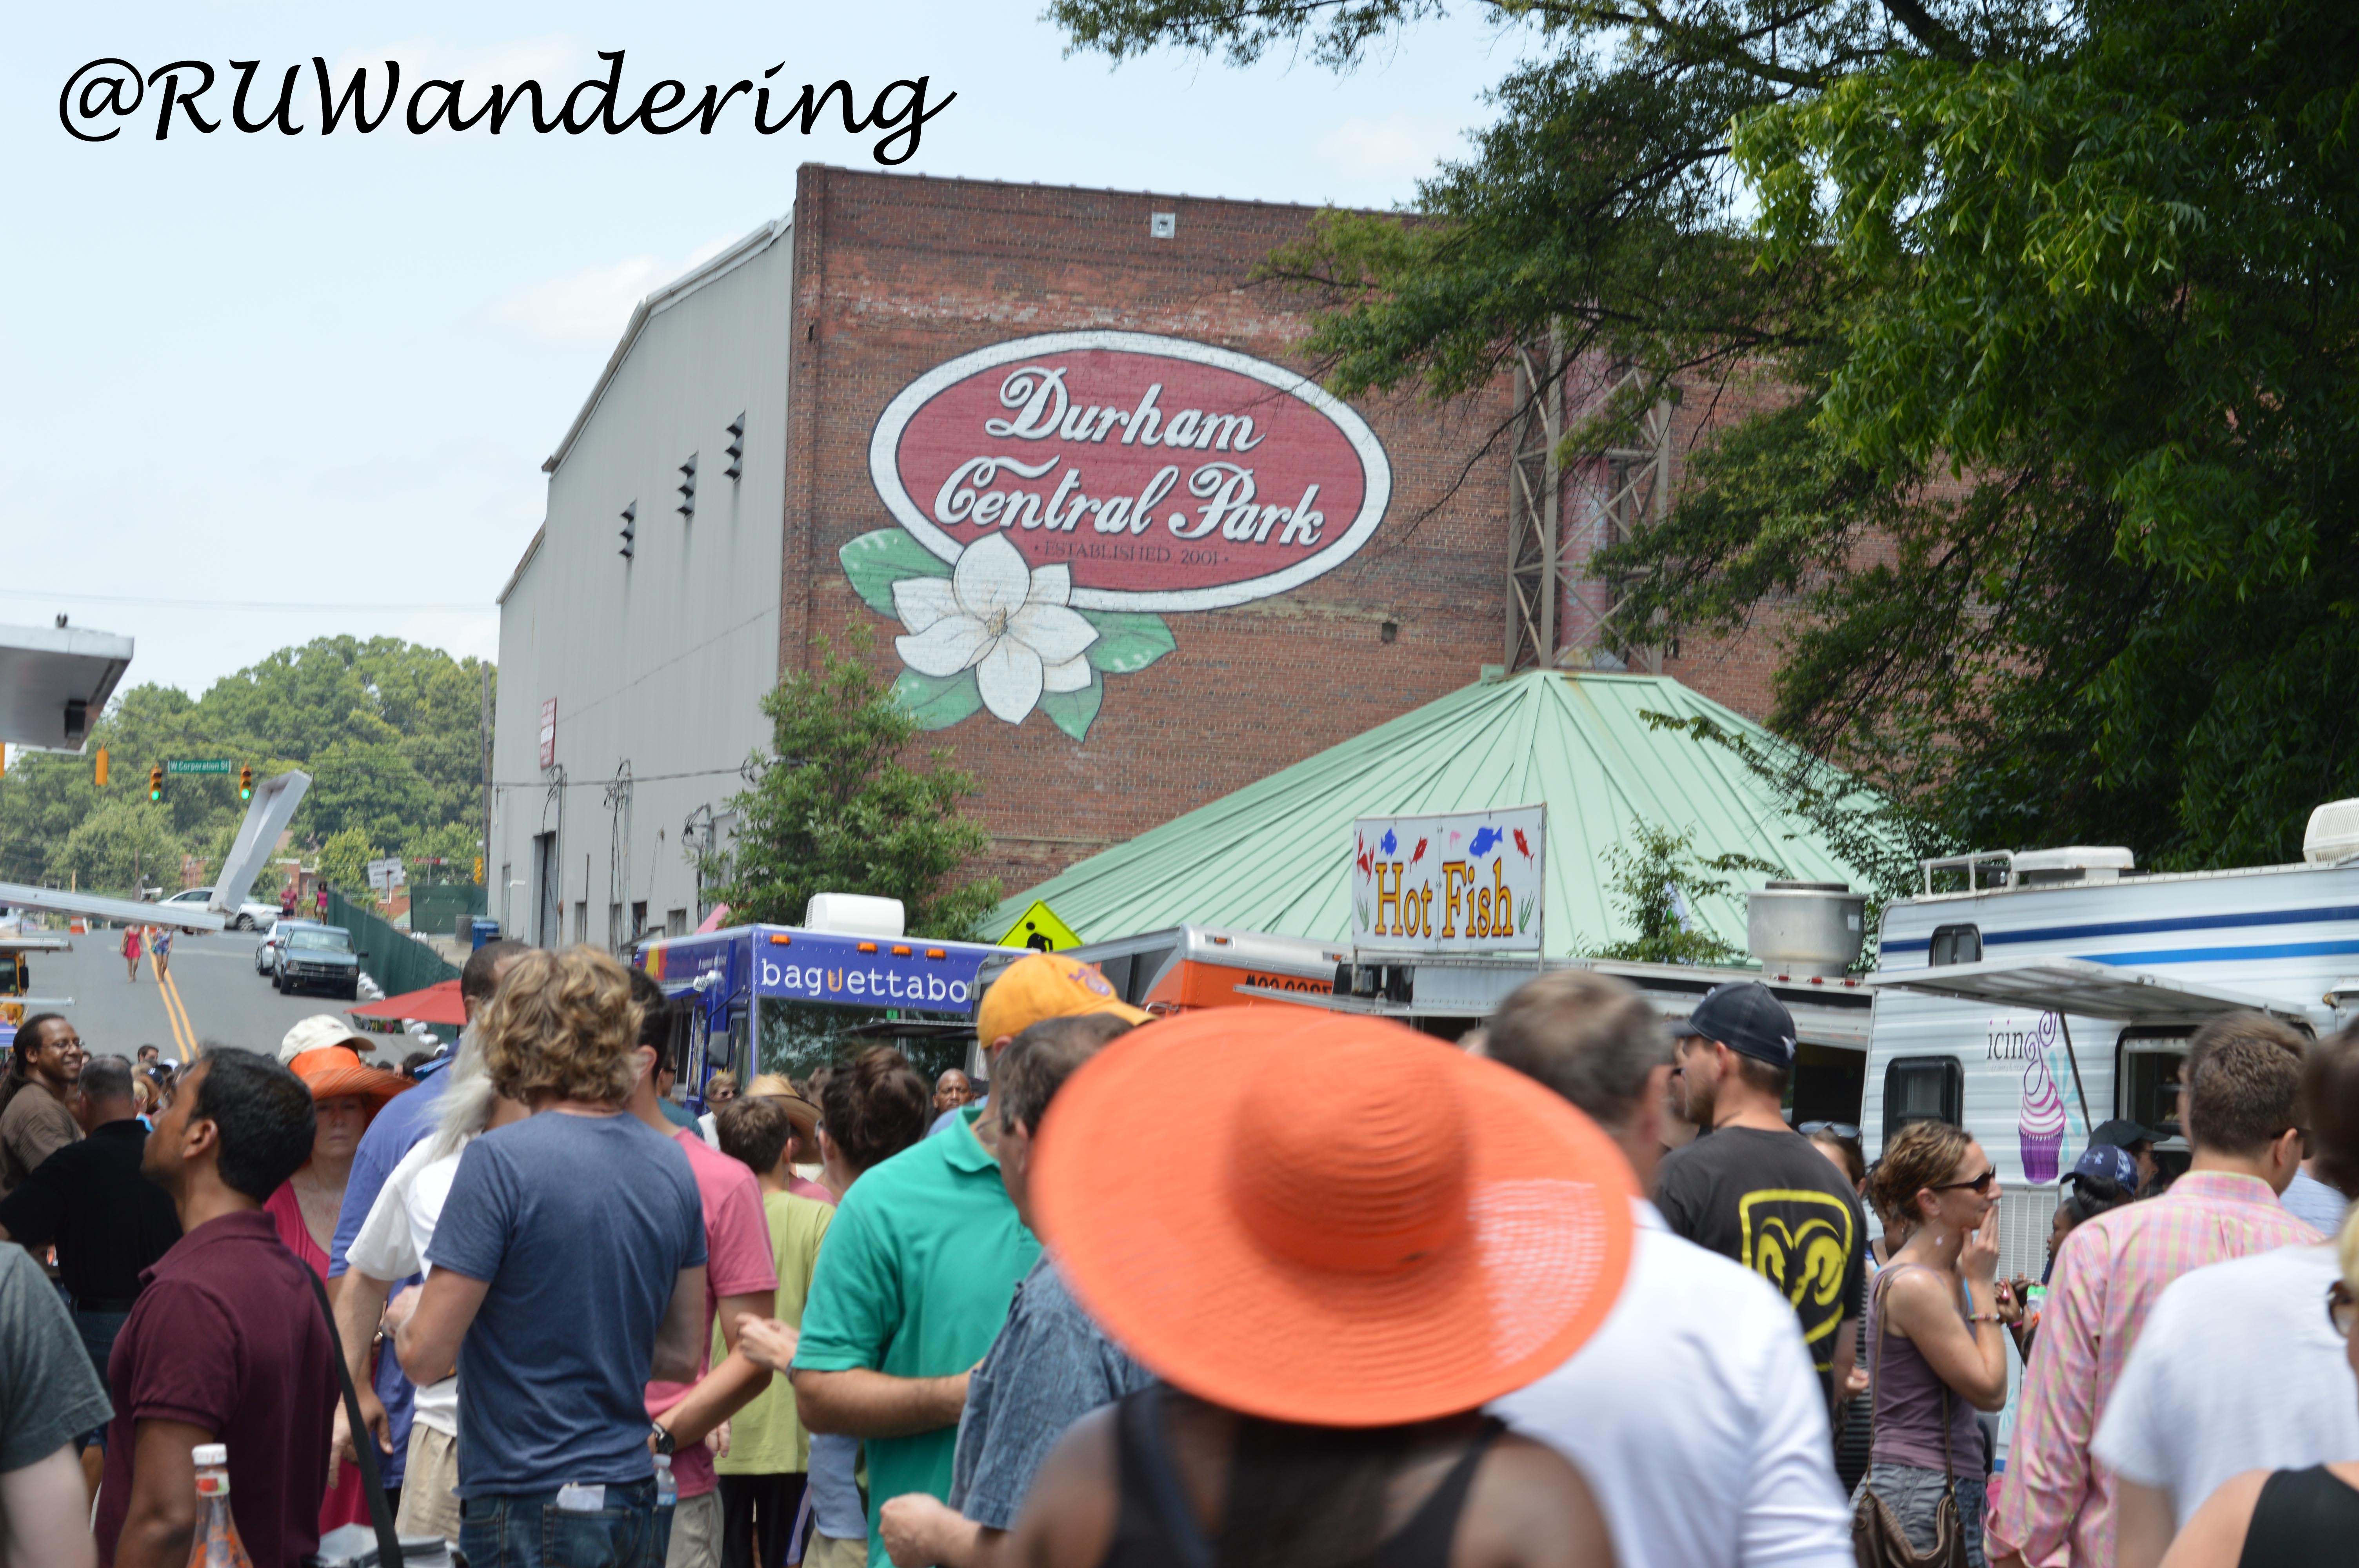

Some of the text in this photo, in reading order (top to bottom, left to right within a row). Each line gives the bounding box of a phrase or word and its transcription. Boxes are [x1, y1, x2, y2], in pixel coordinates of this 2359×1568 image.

[985, 366, 1267, 452] Durham
[934, 454, 1325, 546] Central Park
[1044, 539, 1218, 565] ESTABLISHED 2001
[170, 760, 227, 772] W Corporation St
[1375, 857, 1514, 938] Hot Fish
